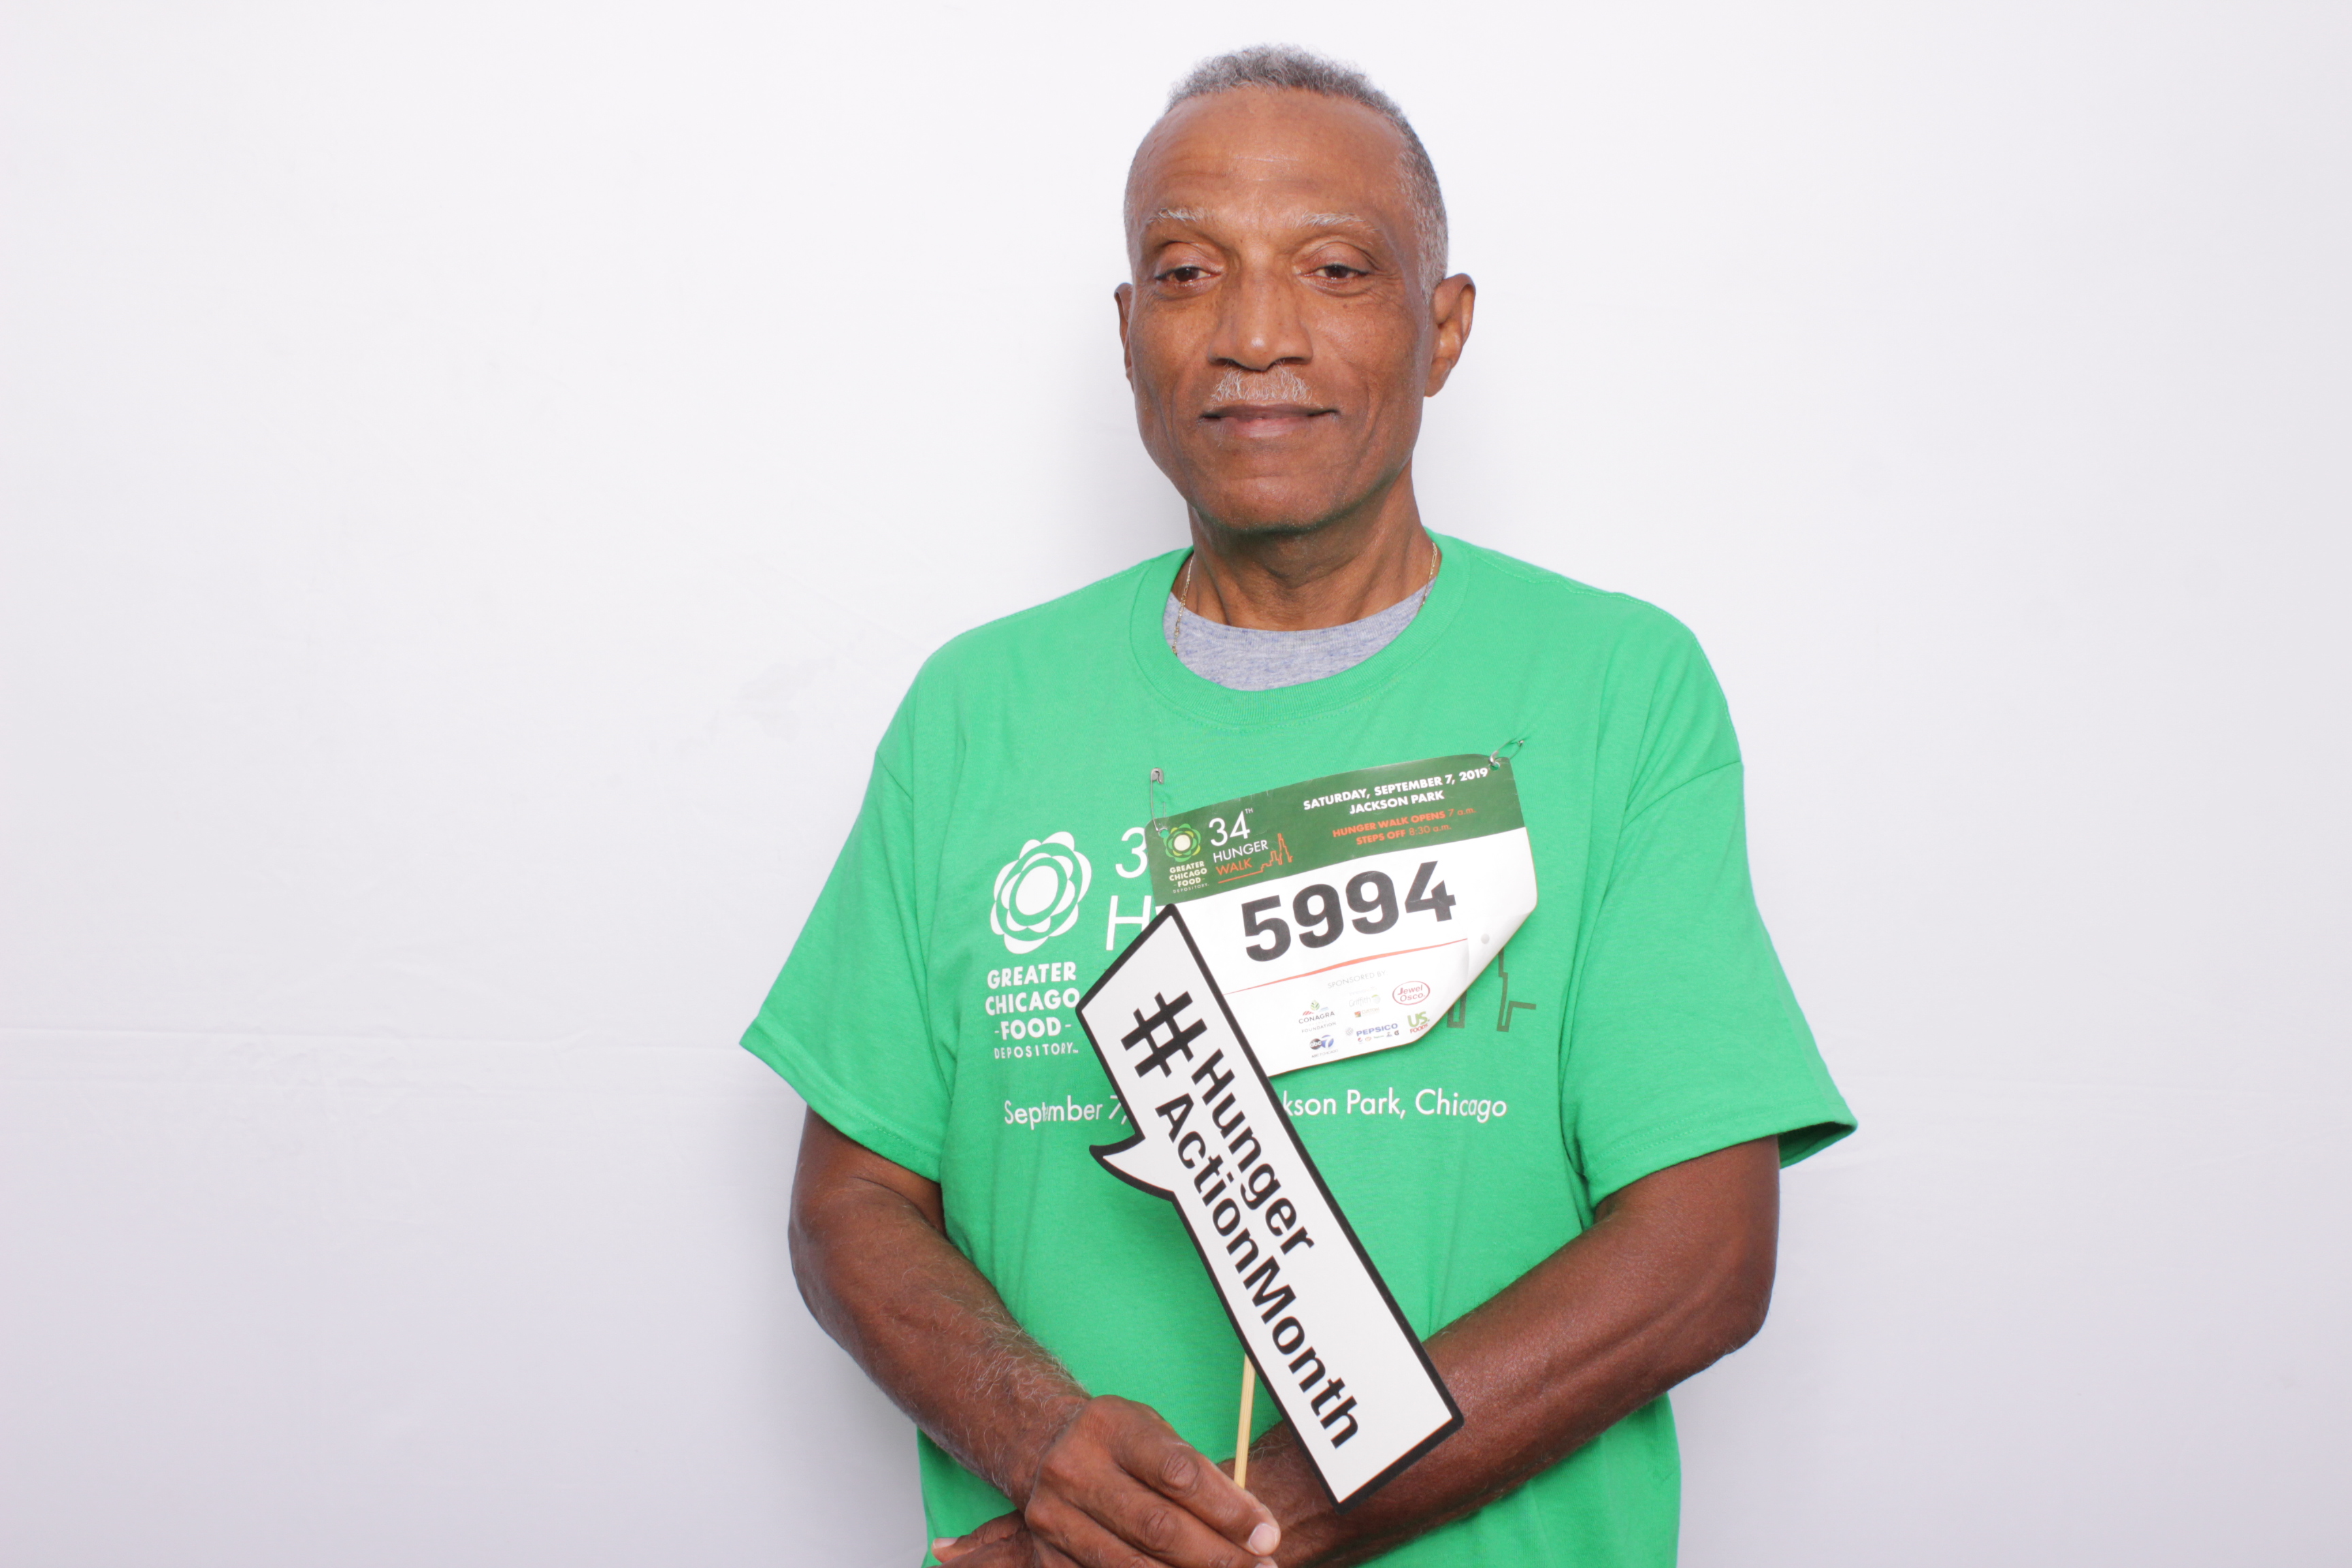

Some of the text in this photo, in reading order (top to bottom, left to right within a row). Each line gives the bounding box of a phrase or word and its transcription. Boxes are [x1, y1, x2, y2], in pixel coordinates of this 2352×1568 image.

[1303, 768, 1488, 810] SATURDAY, SEPTEMBER 7, 2019
[1350, 790, 1445, 815] JACKSON PARK
[1333, 807, 1477, 837] HUNGER WALK OPENS 7 a.m.
[1356, 823, 1452, 845] STEPS OFF 8:30 a.m.
[1213, 840, 1269, 863] HUNGER
[1169, 860, 1205, 873] GREATER
[1169, 868, 1207, 881] CHICAGO
[1215, 858, 1252, 875] WALK
[1241, 860, 1456, 962] 5994
[987, 962, 1076, 989] GREATER
[1328, 972, 1375, 989] SPONSORED
[1397, 985, 1423, 995] Jewel
[985, 987, 1079, 1015] CHICAGO
[1298, 1011, 1335, 1024] CONAGRA
[1301, 1022, 1337, 1033] FOUNDATION
[1356, 1023, 1399, 1036] PEPSICO
[1410, 1023, 1428, 1034] FOODS
[1309, 1040, 1322, 1048] abc
[1283, 1087, 1507, 1124] kson Park, Chicago
[1155, 1093, 1359, 1450] ActionMonth
